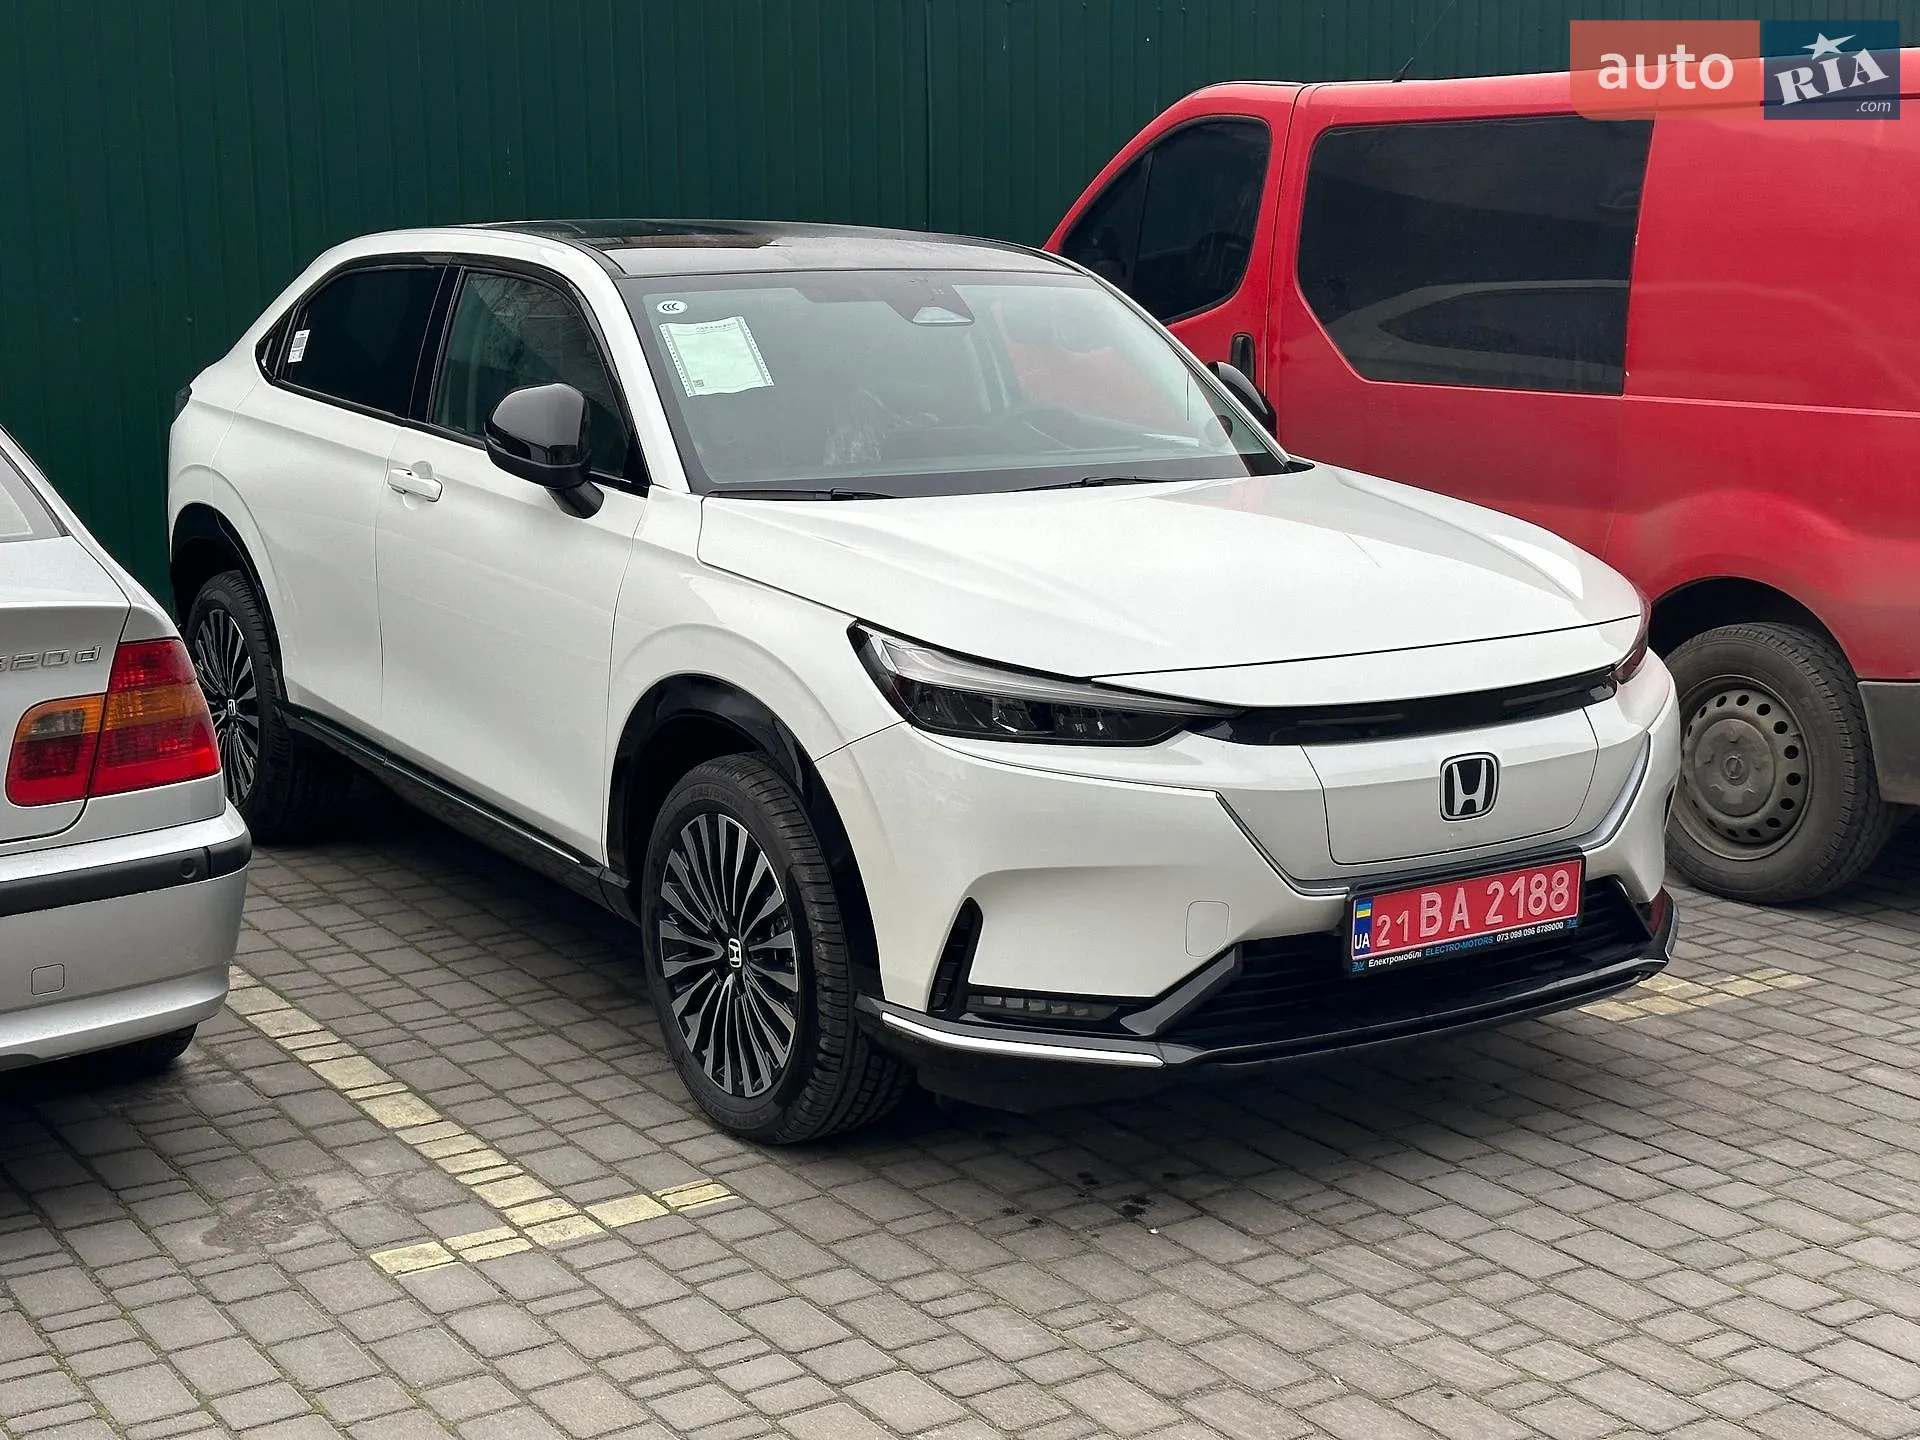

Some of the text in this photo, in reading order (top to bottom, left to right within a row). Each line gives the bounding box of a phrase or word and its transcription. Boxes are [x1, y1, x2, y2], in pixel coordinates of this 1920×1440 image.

[0, 645, 102, 672] 20d
[1354, 869, 1570, 950] UA 21 BA 2188
[1368, 950, 1423, 968] Електромобілі
[1425, 935, 1495, 956] ELECTRO-MOTORS
[1496, 932, 1510, 942] 073
